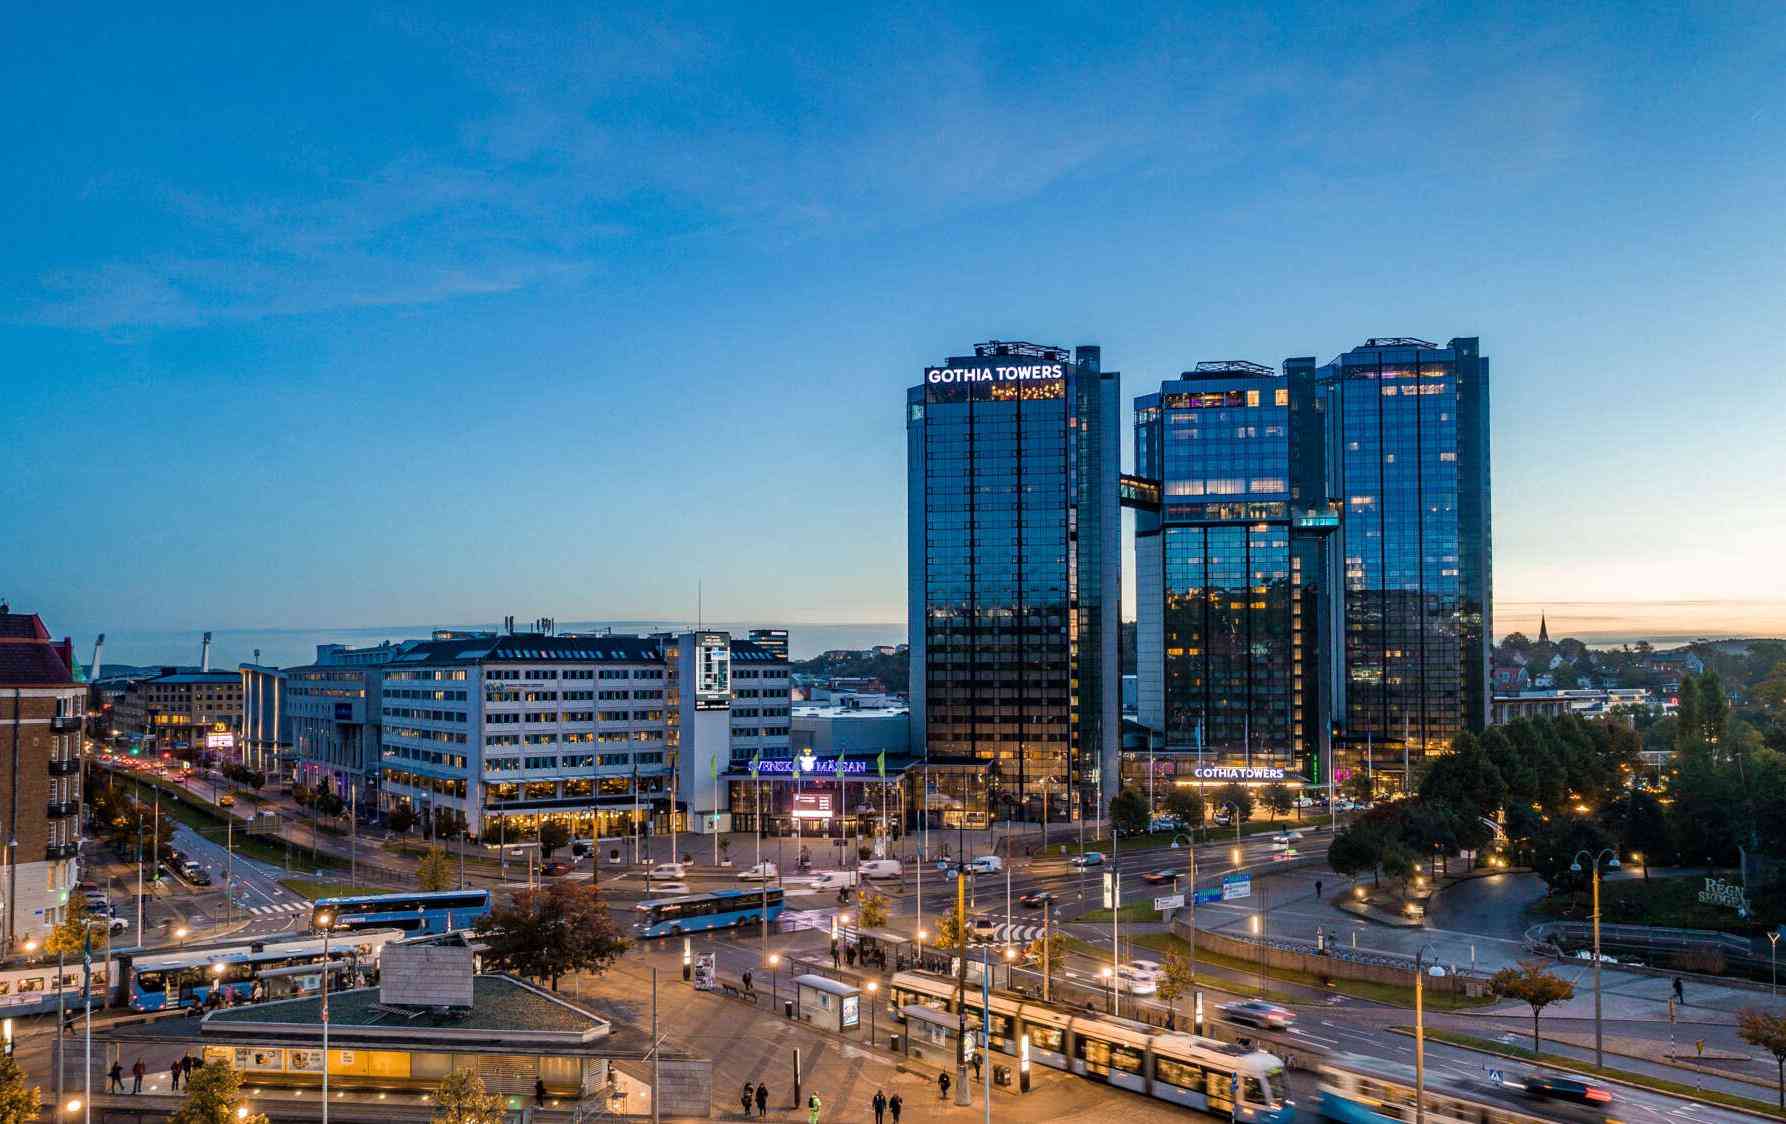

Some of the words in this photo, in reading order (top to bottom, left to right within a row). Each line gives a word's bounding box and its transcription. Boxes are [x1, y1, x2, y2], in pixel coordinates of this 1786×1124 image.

[928, 368, 993, 383] GOTHIA
[995, 365, 1062, 380] TOWERS
[816, 760, 866, 772] MÄSAN
[1195, 768, 1239, 778] GOTHIA
[1239, 768, 1284, 778] TOWERS
